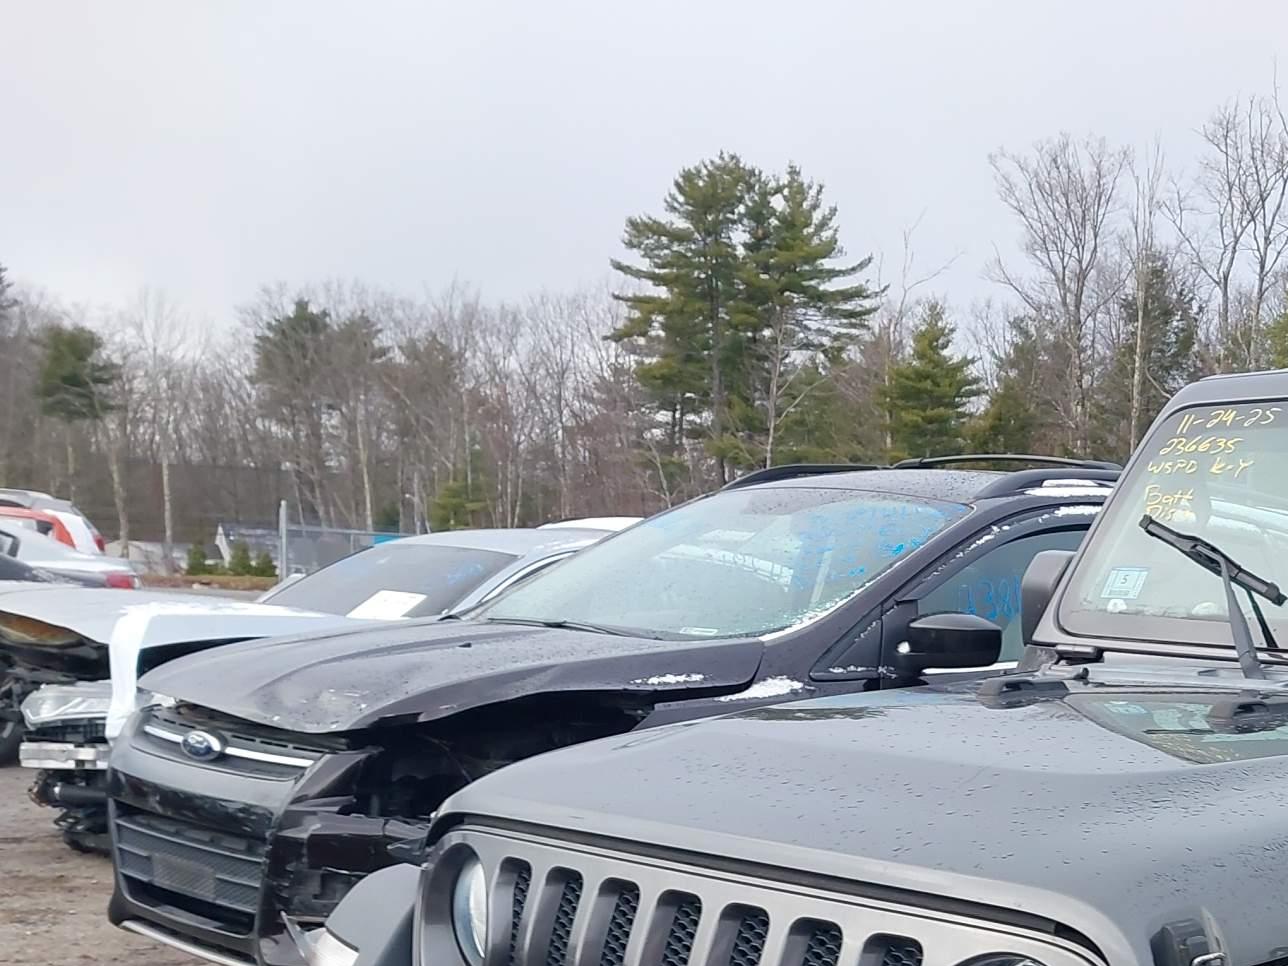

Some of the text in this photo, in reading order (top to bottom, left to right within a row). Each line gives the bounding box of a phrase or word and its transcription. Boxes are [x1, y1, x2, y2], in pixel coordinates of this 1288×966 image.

[1176, 407, 1283, 434] 11-24-25
[1159, 435, 1244, 455] 236635
[1144, 485, 1194, 505] Batt
